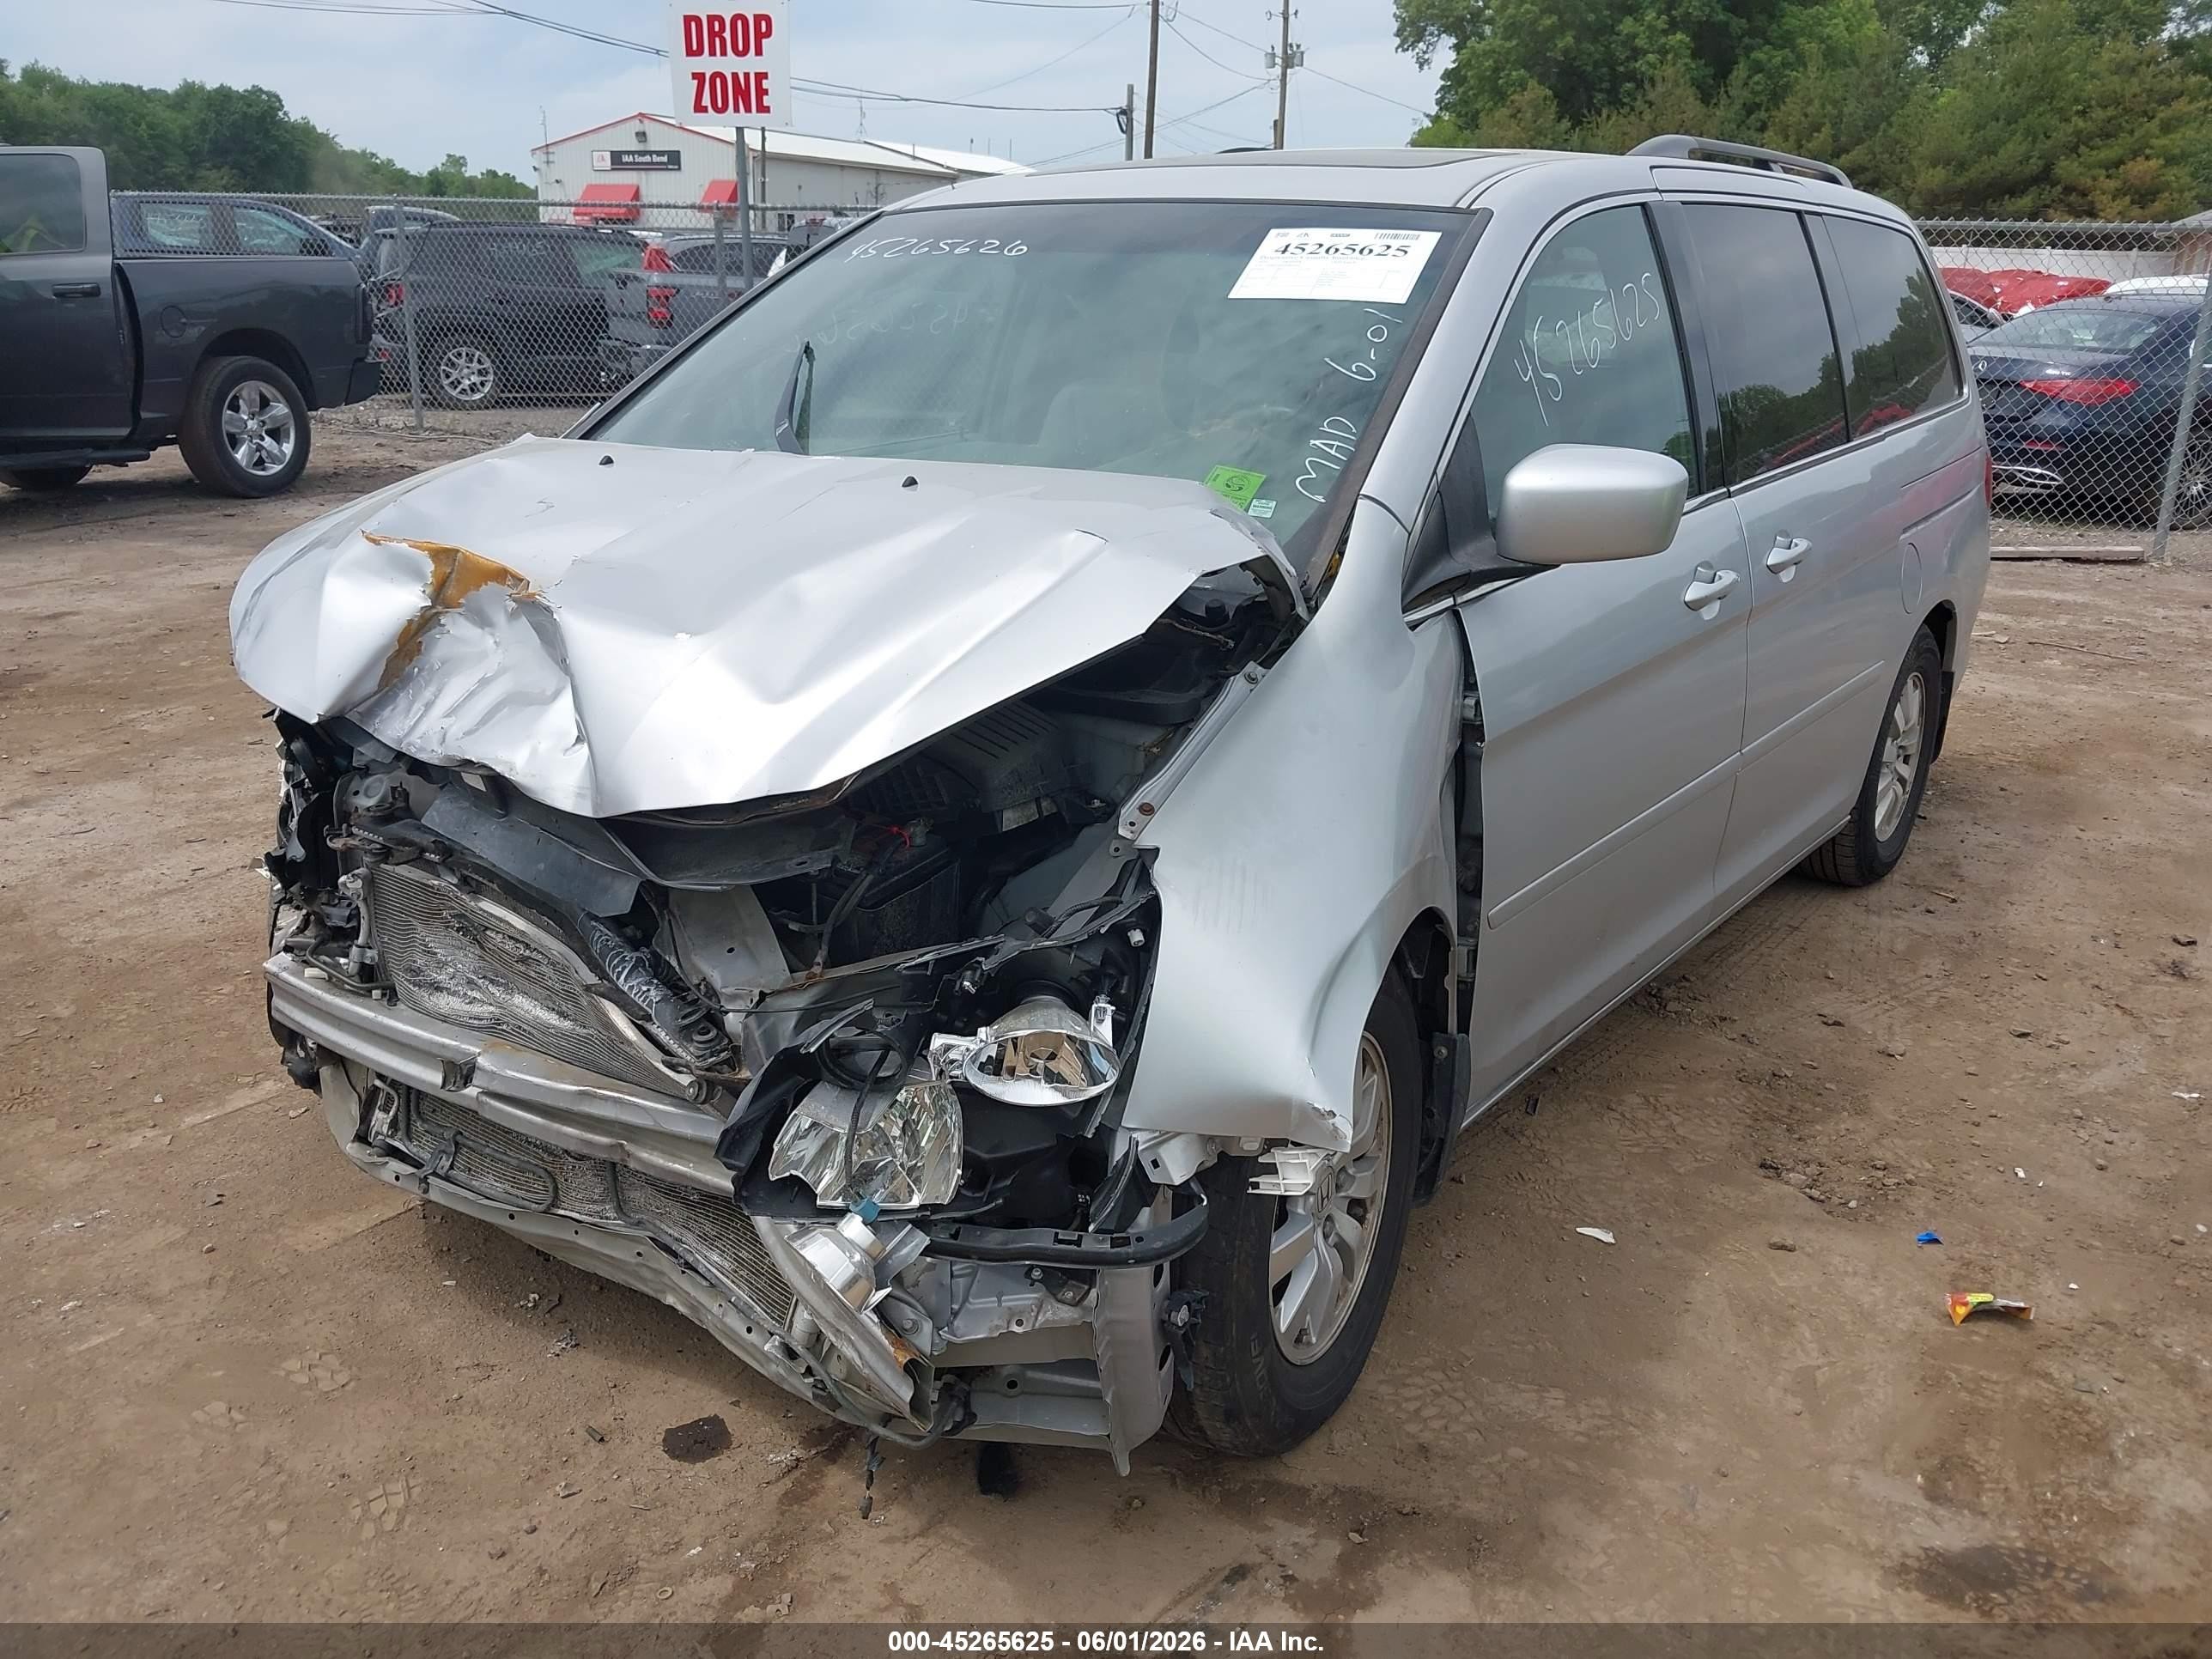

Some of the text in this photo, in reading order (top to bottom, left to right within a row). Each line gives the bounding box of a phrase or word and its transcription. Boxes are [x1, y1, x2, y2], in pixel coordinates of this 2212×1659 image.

[683, 13, 773, 58] DROP
[691, 71, 771, 114] ZONE
[1273, 242, 1411, 258] 45265625
[1324, 307, 1403, 381] 6-01
[1514, 272, 1660, 427] 45265625
[1295, 416, 1357, 502] MAD
